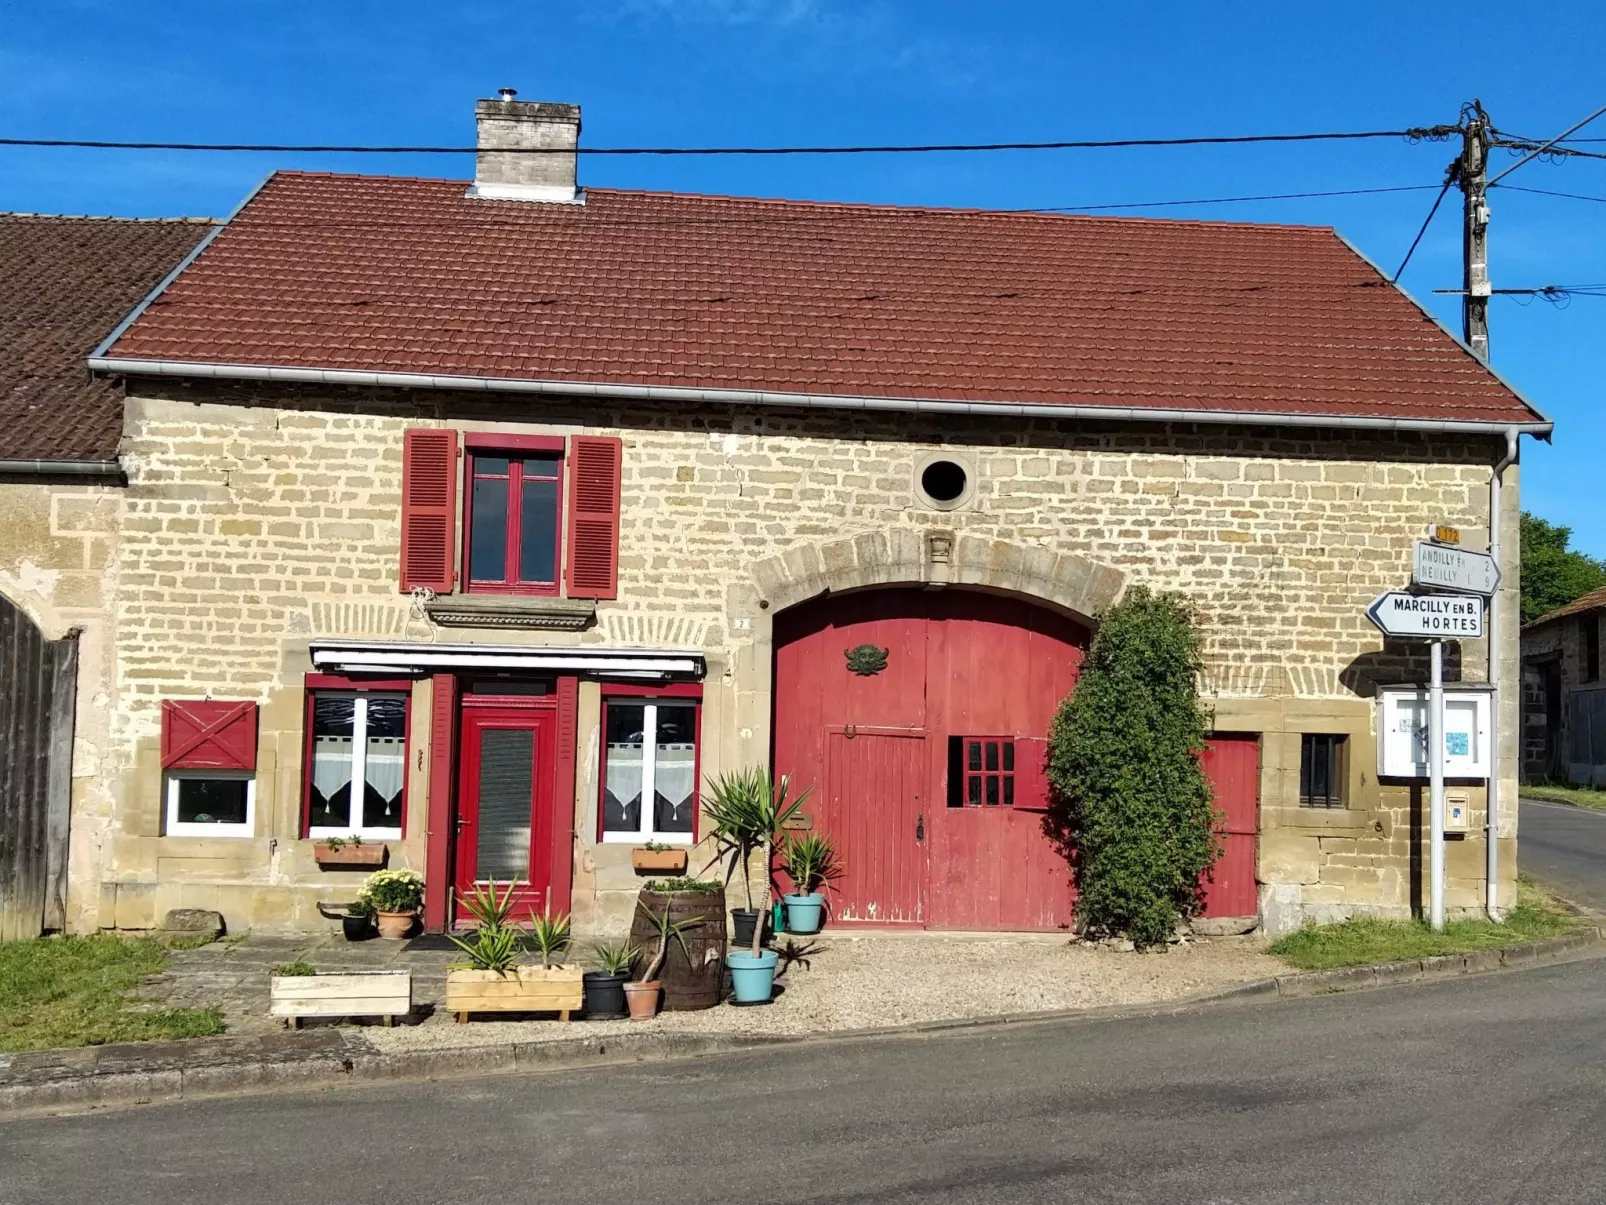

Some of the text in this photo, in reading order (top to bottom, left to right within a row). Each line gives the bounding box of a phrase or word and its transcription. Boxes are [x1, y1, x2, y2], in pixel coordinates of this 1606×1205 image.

[1444, 528, 1458, 543] 172
[1422, 549, 1454, 566] ANDILLY
[1484, 560, 1490, 573] 2
[1484, 576, 1490, 588] 9
[1394, 599, 1477, 615] MARCILLY EN B.
[1422, 616, 1477, 631] HORTES
